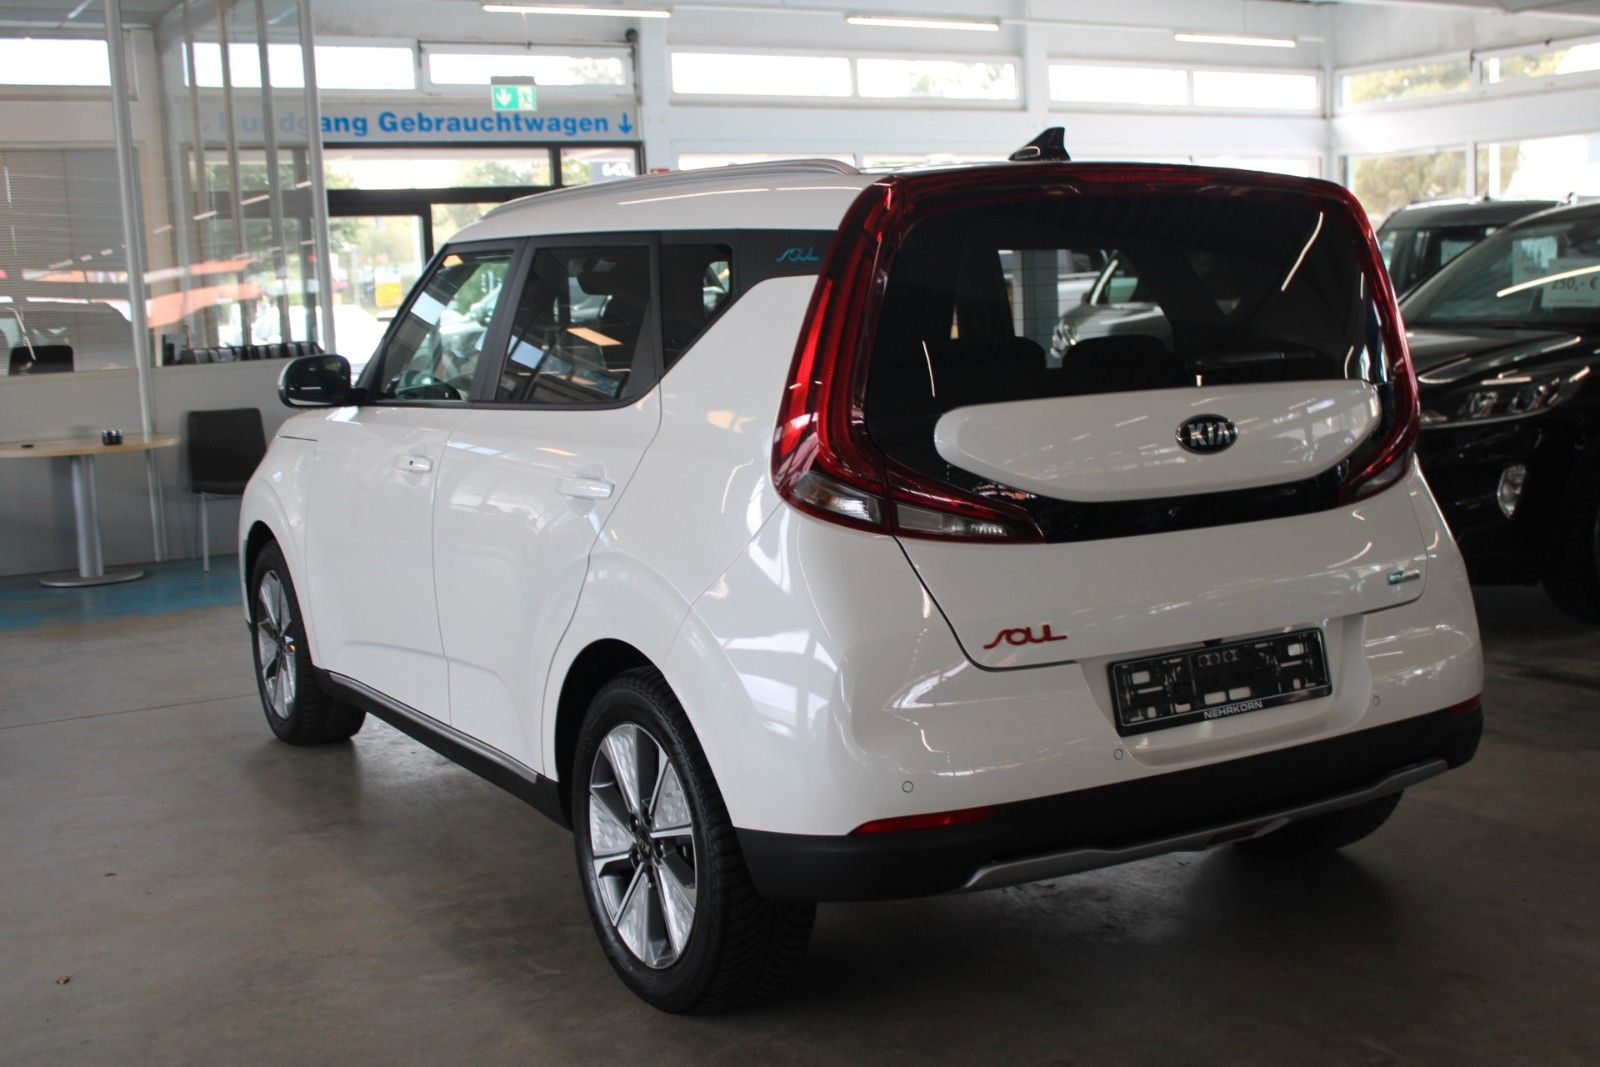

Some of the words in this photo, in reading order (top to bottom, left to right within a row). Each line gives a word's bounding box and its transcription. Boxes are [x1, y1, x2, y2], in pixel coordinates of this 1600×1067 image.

[378, 111, 609, 136] Gebrauchtwagen
[1187, 422, 1231, 446] KIA
[1203, 700, 1263, 719] NEHRKORN
